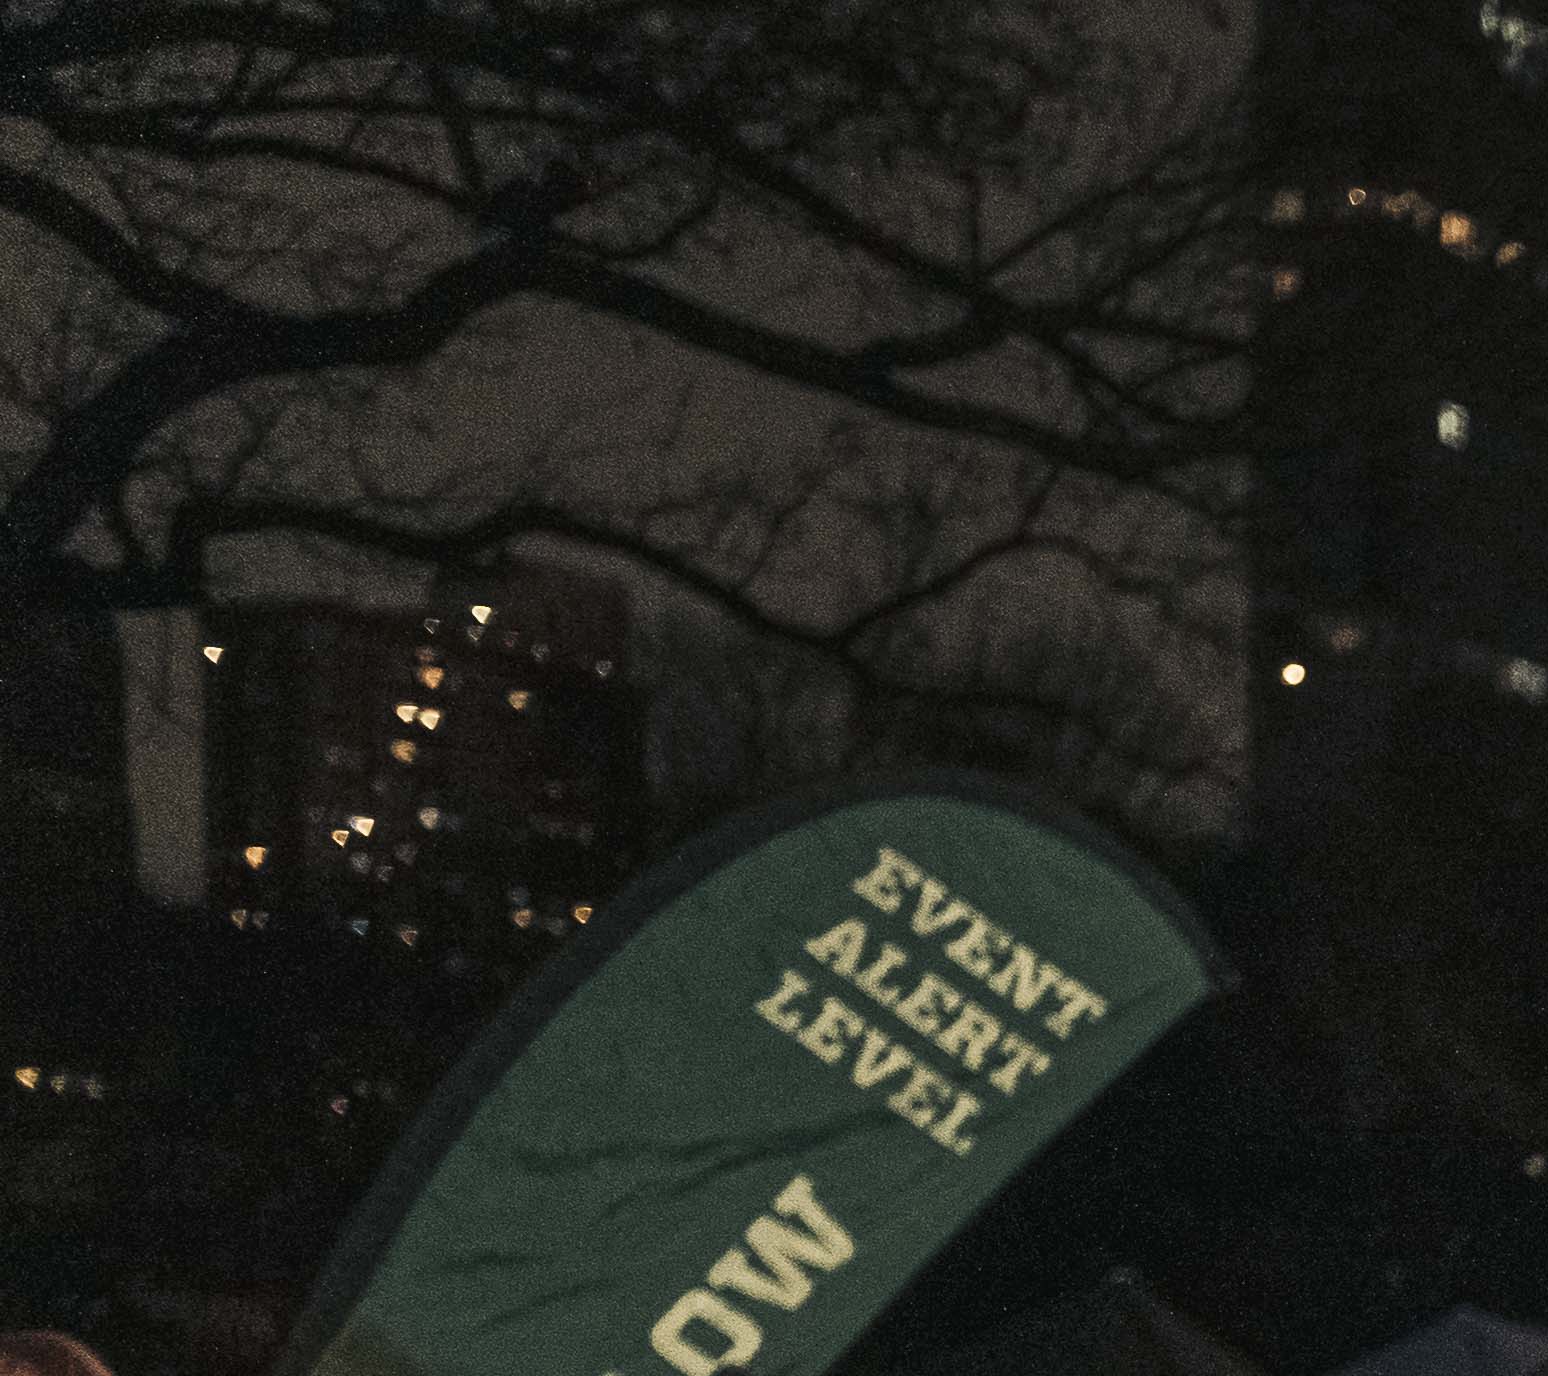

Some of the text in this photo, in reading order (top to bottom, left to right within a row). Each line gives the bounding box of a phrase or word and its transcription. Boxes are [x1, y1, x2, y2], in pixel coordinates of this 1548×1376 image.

[803, 921, 1050, 1095] ALERT
[851, 847, 1107, 1038] EVENT
[755, 971, 977, 1155] LEVEL
